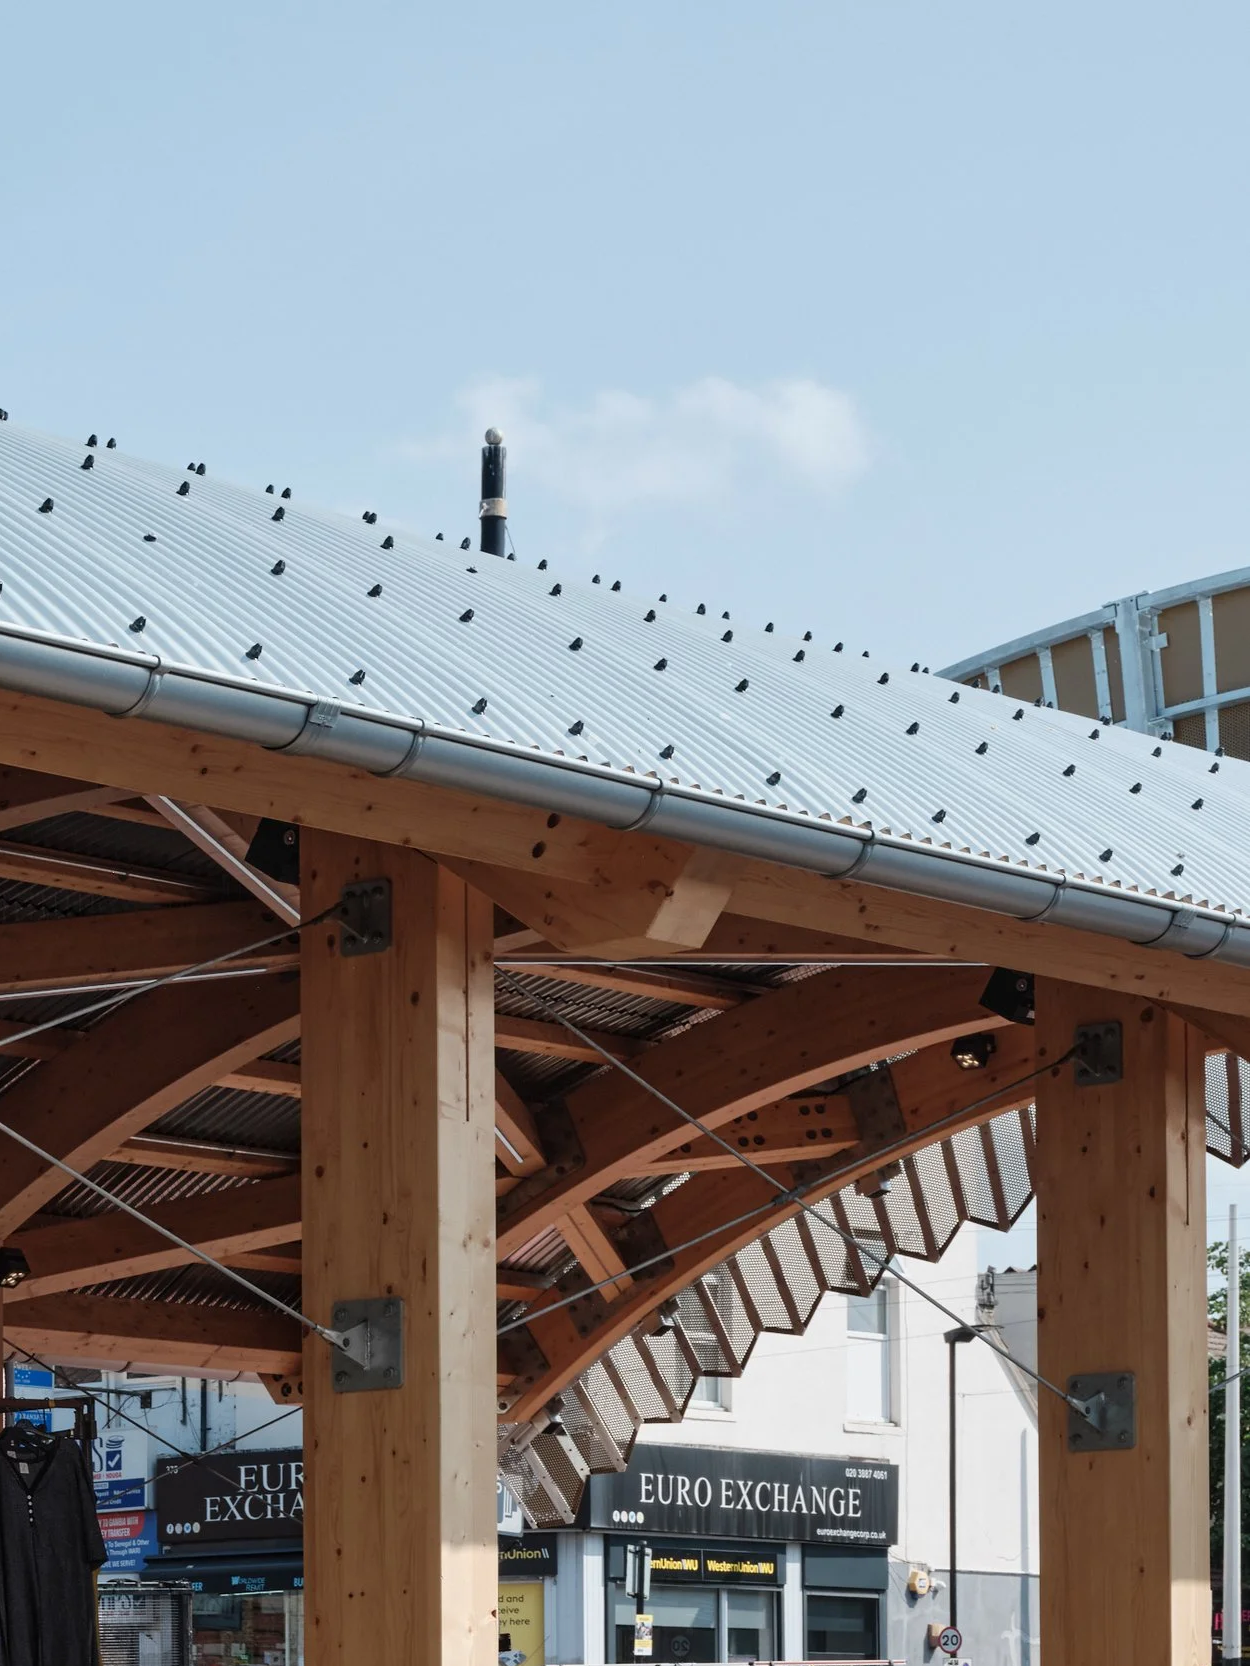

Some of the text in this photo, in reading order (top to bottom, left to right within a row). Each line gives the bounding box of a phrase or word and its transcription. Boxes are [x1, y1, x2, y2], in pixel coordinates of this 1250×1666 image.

[639, 1472, 862, 1518] EURO EXCHANGE
[816, 1528, 887, 1540] euroexchangecorp.co.uk
[110, 1548, 127, 1556] Through
[245, 1583, 265, 1591] REMIT
[505, 1594, 525, 1603] and
[509, 1617, 531, 1626] here
[941, 1634, 959, 1646] 20
